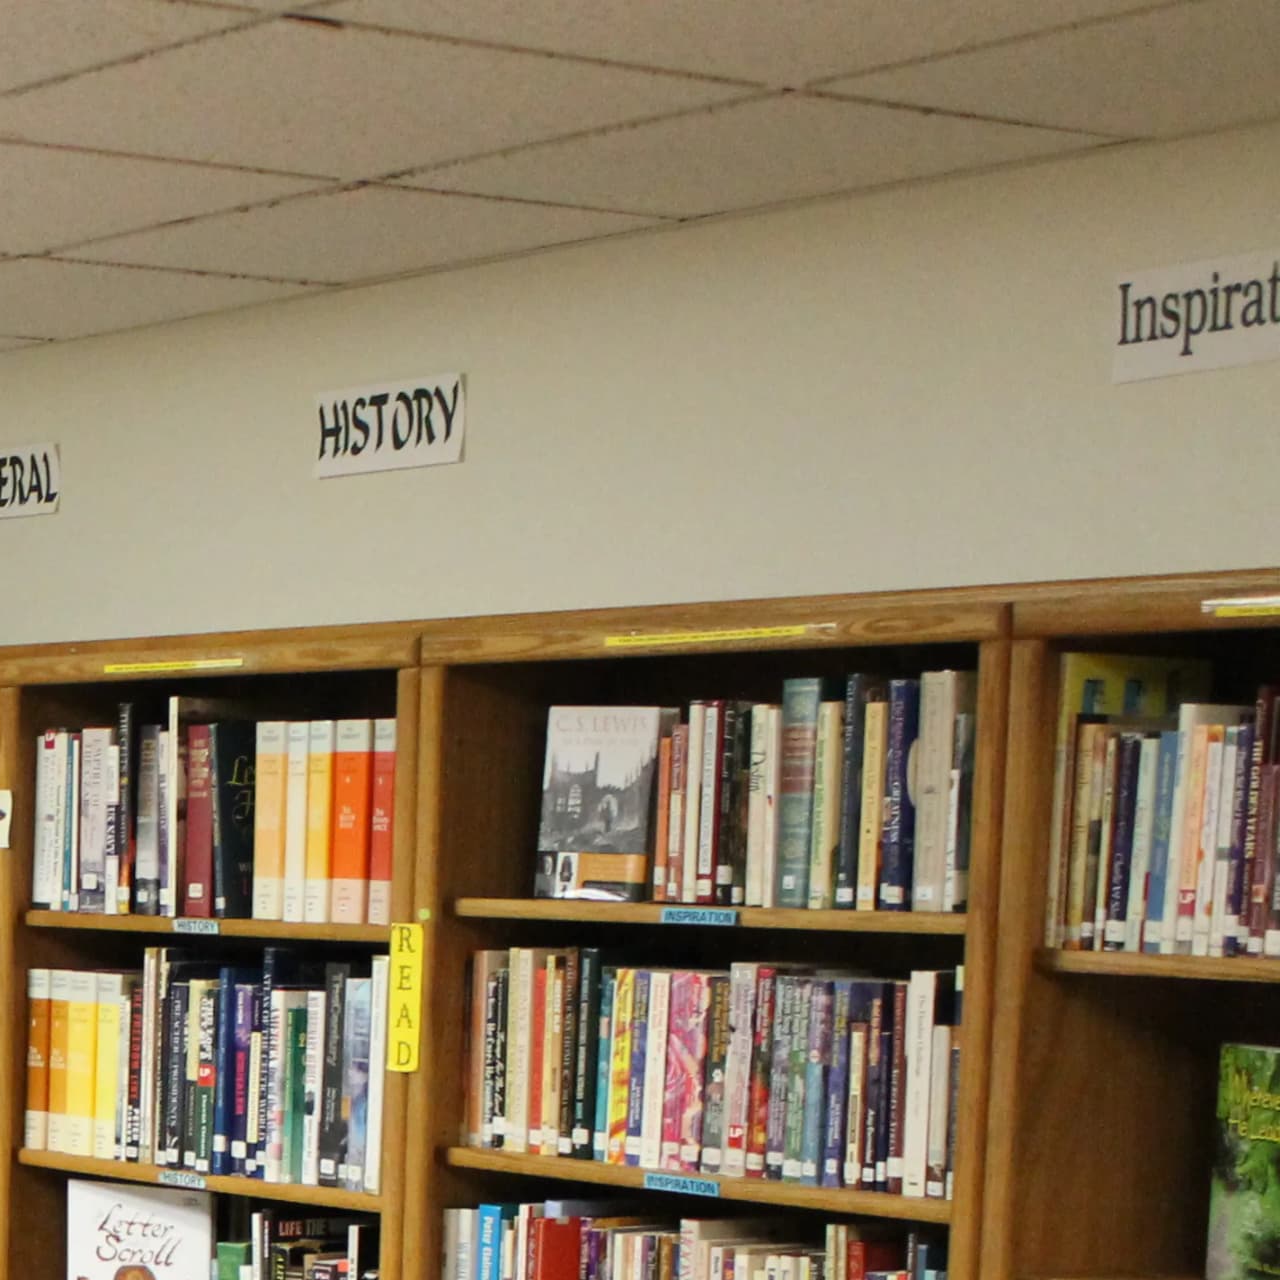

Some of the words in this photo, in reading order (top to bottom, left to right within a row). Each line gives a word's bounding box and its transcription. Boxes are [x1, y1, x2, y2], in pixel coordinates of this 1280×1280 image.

[318, 381, 458, 459] HISTORY
[1253, 741, 1263, 765] THE
[1247, 769, 1262, 815] GOLDEN
[890, 781, 900, 841] GREATNESS
[1244, 819, 1257, 858] YEARS
[177, 919, 217, 932] HISTORY
[664, 911, 734, 921] INSPIRATION
[163, 1173, 204, 1187] HISTORY
[647, 1174, 716, 1194] INSPIRATION
[480, 1215, 493, 1252] Patsy
